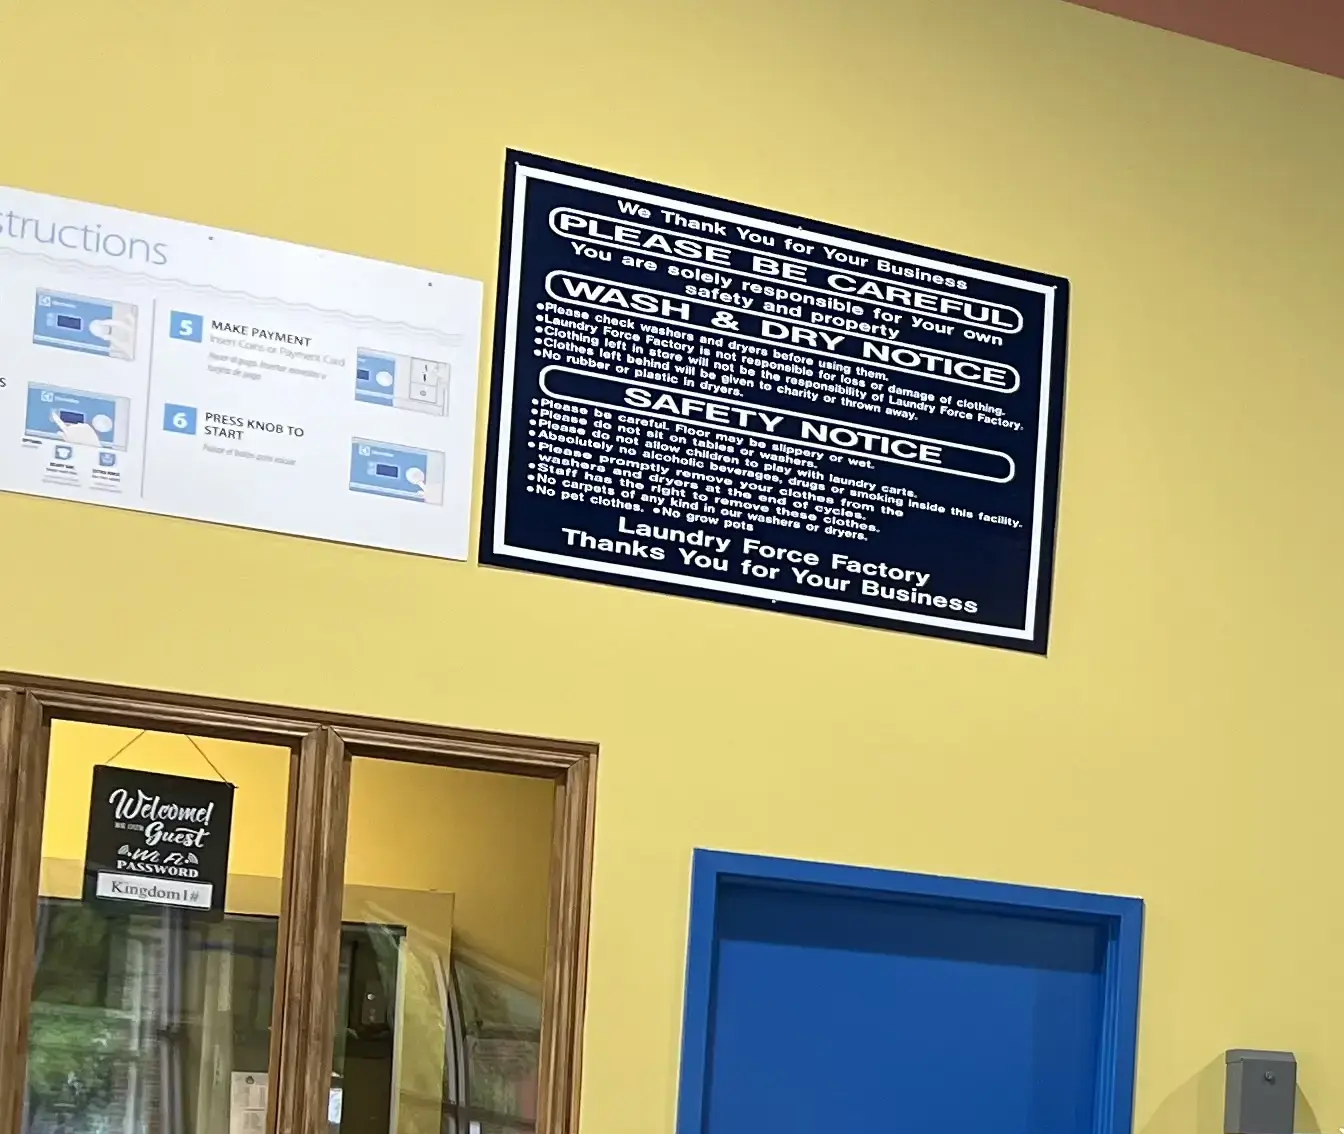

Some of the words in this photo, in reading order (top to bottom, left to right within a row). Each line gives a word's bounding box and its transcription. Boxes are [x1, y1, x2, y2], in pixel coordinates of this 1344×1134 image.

[0, 210, 168, 265] tructions
[617, 200, 651, 218] We
[661, 210, 726, 236] Thank
[736, 227, 775, 247] You
[784, 238, 814, 255] for
[823, 246, 869, 267] Your
[877, 259, 967, 290] Business
[560, 213, 731, 266] PLEASE
[752, 256, 807, 283] BE
[827, 274, 1013, 328] CAREFUL
[571, 241, 612, 261] You
[621, 256, 657, 271] are
[668, 265, 732, 289] solely
[742, 281, 864, 315] responsible
[873, 308, 902, 324] for
[912, 316, 955, 335] your
[963, 330, 1003, 346] own
[179, 320, 193, 336] 5
[211, 320, 248, 336] MAKE
[251, 328, 312, 347] PAYMENT
[546, 302, 590, 320] Please
[594, 314, 635, 329] check
[640, 324, 694, 341] washers
[699, 336, 723, 347] and
[728, 340, 768, 356] dryers
[773, 349, 814, 365] before
[818, 360, 851, 375] using
[856, 366, 889, 381] them.
[562, 277, 690, 321] WASH
[711, 311, 739, 331] &
[761, 320, 845, 351] DRY
[863, 341, 1006, 386] NOTICE
[685, 285, 754, 309] safety
[763, 302, 802, 318] and
[811, 311, 900, 340] property
[543, 348, 561, 361] No
[566, 355, 610, 370] rubber
[615, 365, 630, 374] or
[634, 368, 678, 384] plastic
[683, 376, 695, 387] in
[700, 381, 743, 397] dryers.
[545, 314, 598, 334] Laundry
[603, 325, 640, 342] Force
[646, 334, 695, 354] Factory
[699, 345, 711, 356] is
[715, 351, 737, 362] not
[741, 356, 813, 377] responsible
[818, 369, 836, 381] for
[840, 374, 866, 387] loss
[870, 382, 884, 391] or
[887, 384, 935, 402] damage
[939, 396, 952, 405] of
[956, 399, 1005, 416] clothing.
[172, 412, 188, 428] 6
[204, 426, 244, 441] START
[205, 412, 244, 427] PRESS
[247, 419, 283, 434] KNOB
[287, 426, 305, 438] TO
[541, 398, 588, 415] Please
[594, 408, 612, 419] be
[618, 415, 670, 430] careful.
[675, 423, 711, 438] Floor
[715, 433, 744, 445] may
[749, 437, 766, 449] be
[772, 443, 824, 461] slippery
[829, 455, 844, 463] or
[848, 458, 874, 469] wet.
[624, 388, 784, 432] SAFETY
[801, 421, 942, 464] NOTICE
[538, 430, 613, 453] Absolutely
[619, 446, 637, 455] no
[642, 450, 704, 468] alcoholic
[710, 461, 783, 484] beverages,
[788, 477, 825, 491] drugs
[831, 486, 845, 494] or
[850, 490, 903, 507] smoking
[908, 498, 946, 513] inside
[951, 507, 973, 518] this
[978, 512, 1022, 528] facility.
[562, 527, 665, 560] Thanks
[678, 548, 728, 571] You
[741, 559, 780, 579] for
[791, 567, 850, 591] Your
[862, 579, 978, 613] Business
[618, 516, 731, 553] Laundry
[743, 538, 819, 566] Force
[832, 553, 930, 587] Factory
[108, 788, 215, 826] Welcome!
[144, 821, 210, 848] Guest
[116, 860, 199, 878] PASSWORD
